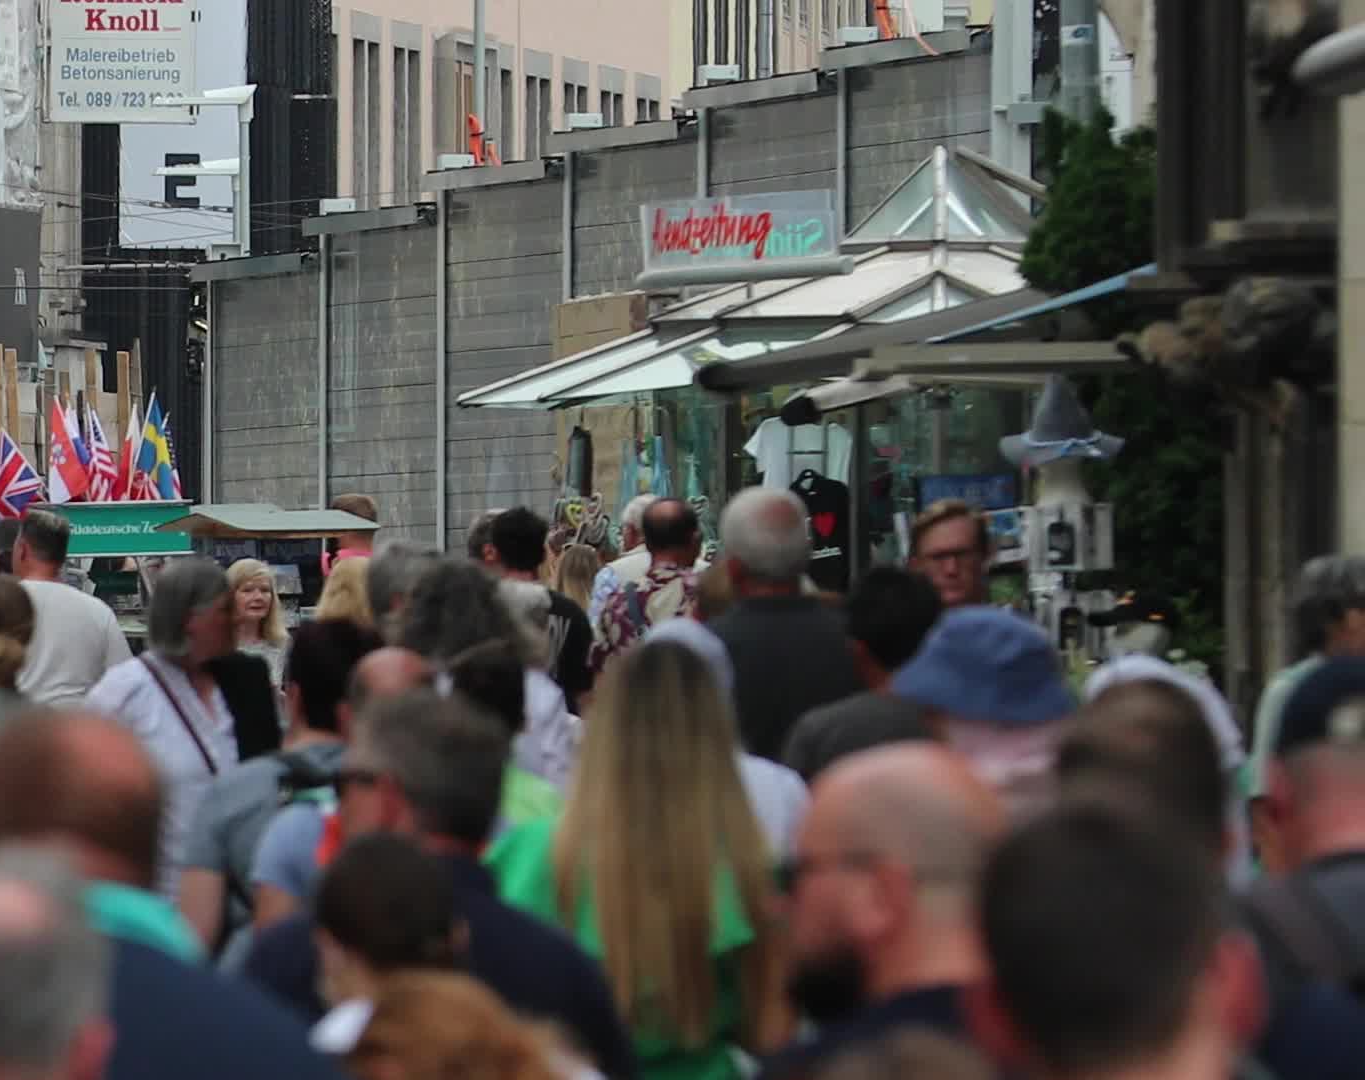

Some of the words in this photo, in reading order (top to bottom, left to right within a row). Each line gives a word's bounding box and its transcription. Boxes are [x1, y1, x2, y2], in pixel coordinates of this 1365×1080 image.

[84, 8, 160, 31] Knoll
[65, 48, 176, 63] Malereibetrieb
[60, 65, 181, 84] Betonsanierung
[59, 92, 80, 107] Tel.
